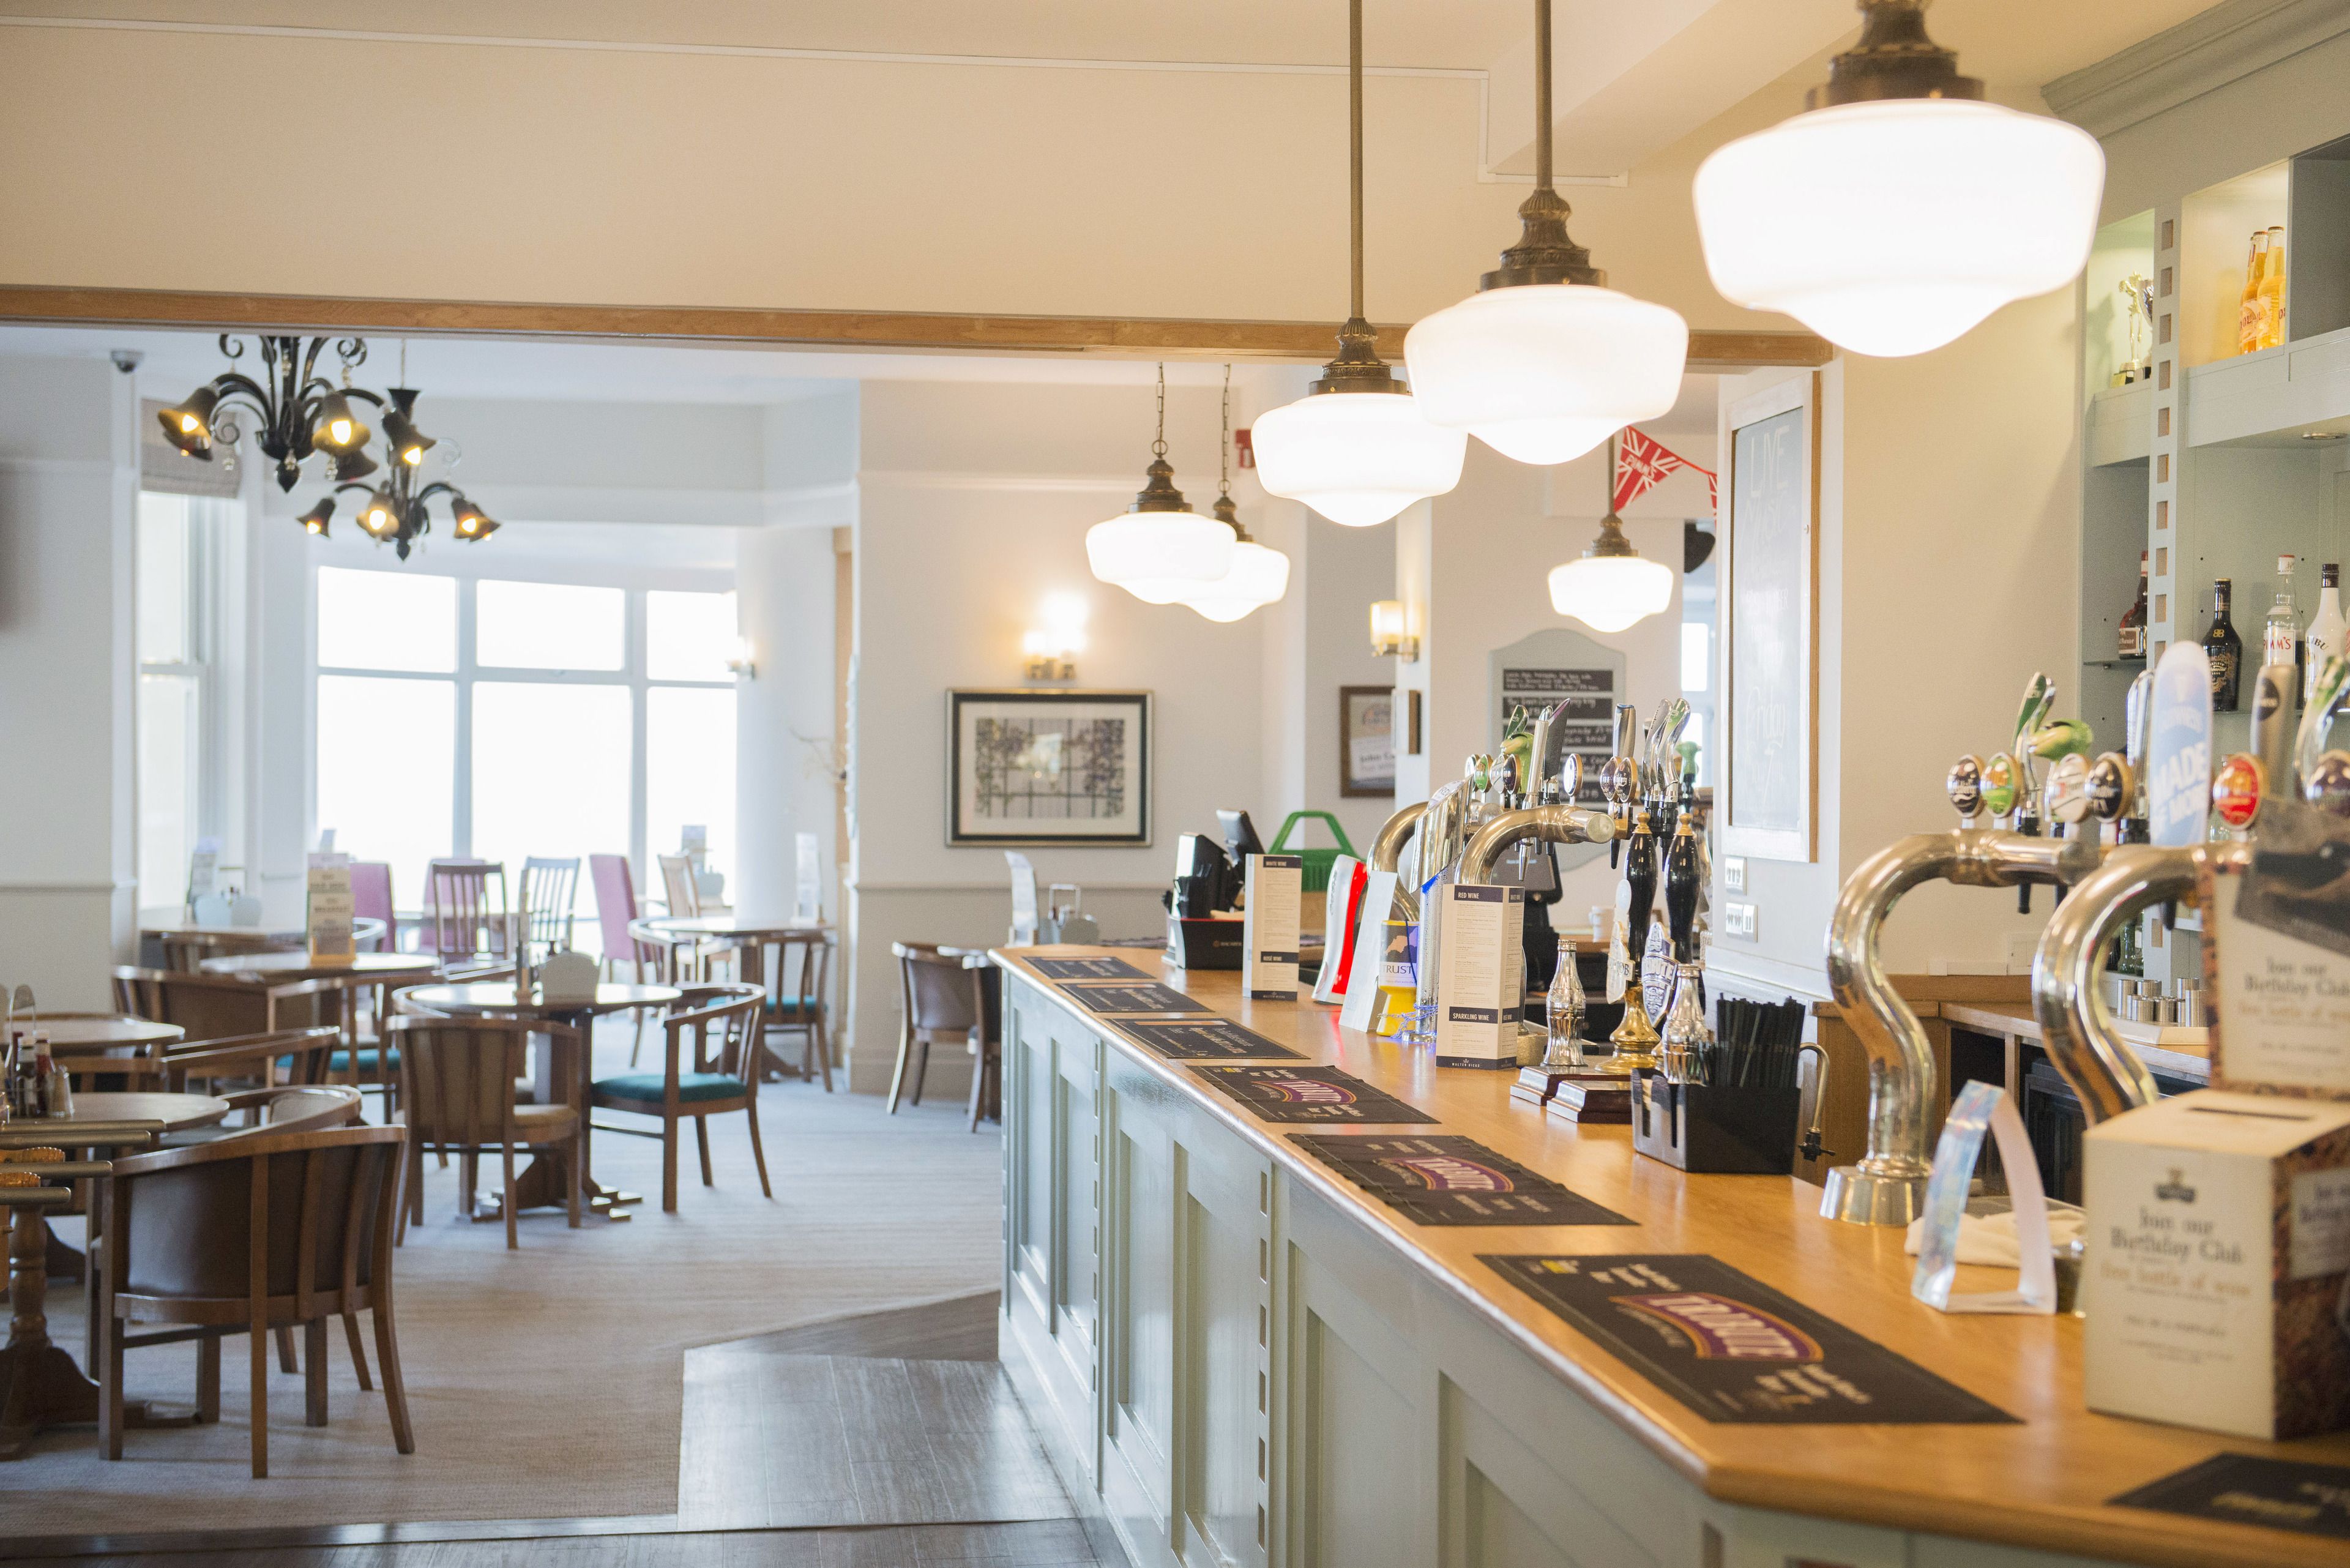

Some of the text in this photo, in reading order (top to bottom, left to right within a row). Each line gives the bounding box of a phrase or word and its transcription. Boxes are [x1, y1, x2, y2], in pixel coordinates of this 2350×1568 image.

[1750, 425, 1790, 498] LIVE
[1383, 965, 1412, 974] TRUST
[2111, 1225, 2242, 1265] Birthday Club
